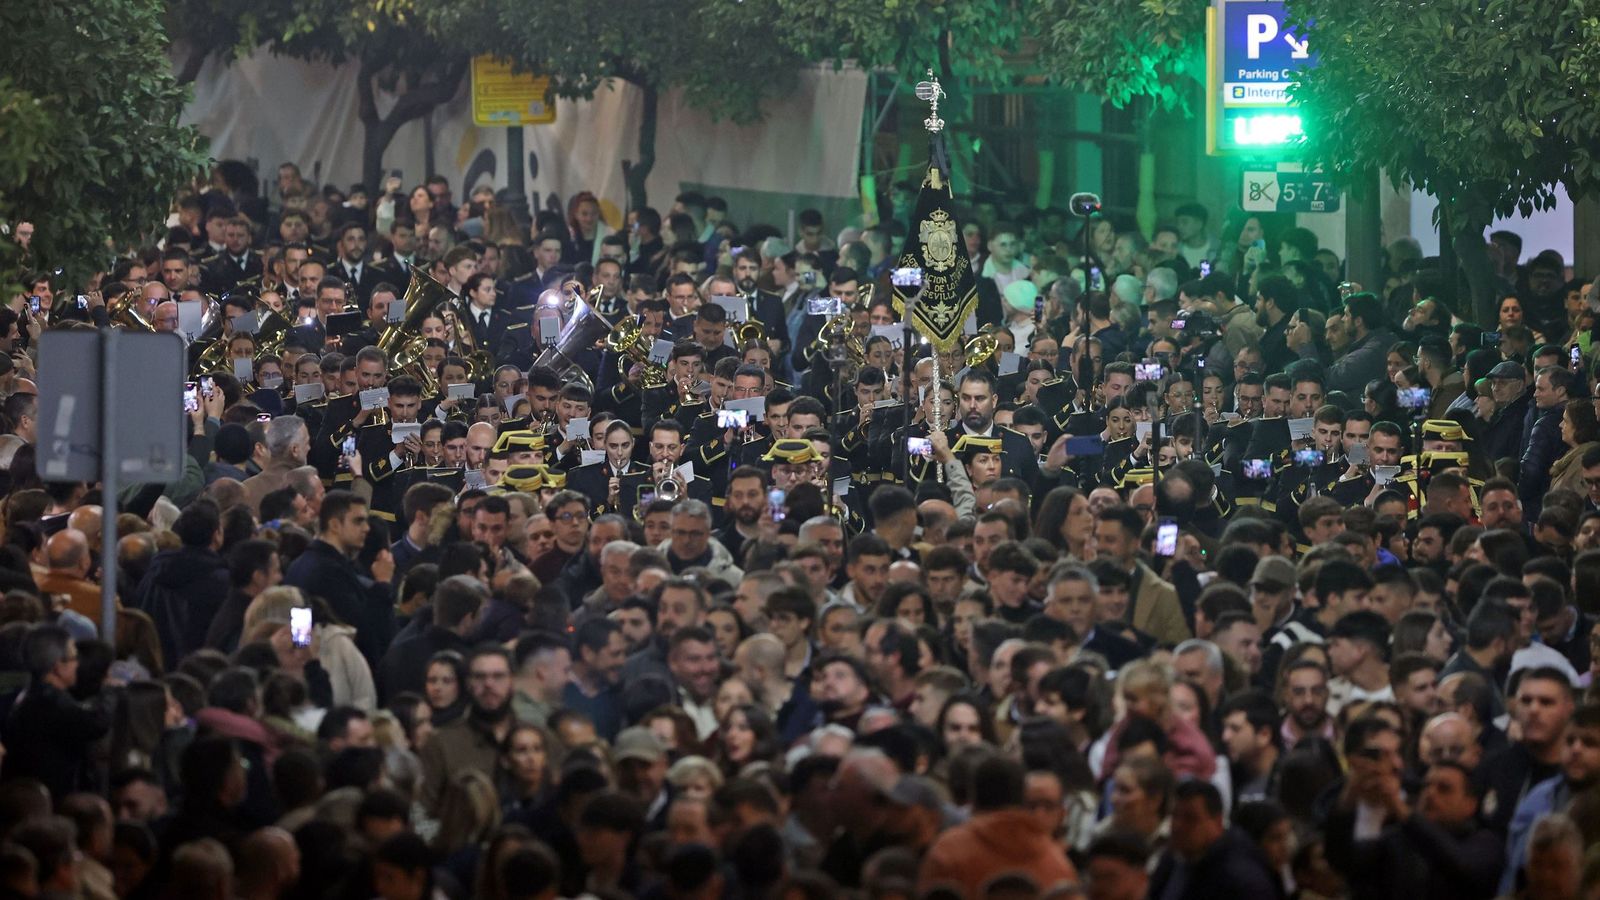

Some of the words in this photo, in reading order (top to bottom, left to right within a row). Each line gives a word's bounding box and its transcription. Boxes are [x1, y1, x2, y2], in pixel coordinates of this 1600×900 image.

[1247, 14, 1279, 59] P
[1238, 69, 1279, 81] Parking
[1247, 87, 1286, 99] Interp
[923, 290, 957, 300] SEVILLA
[934, 285, 946, 293] DE
